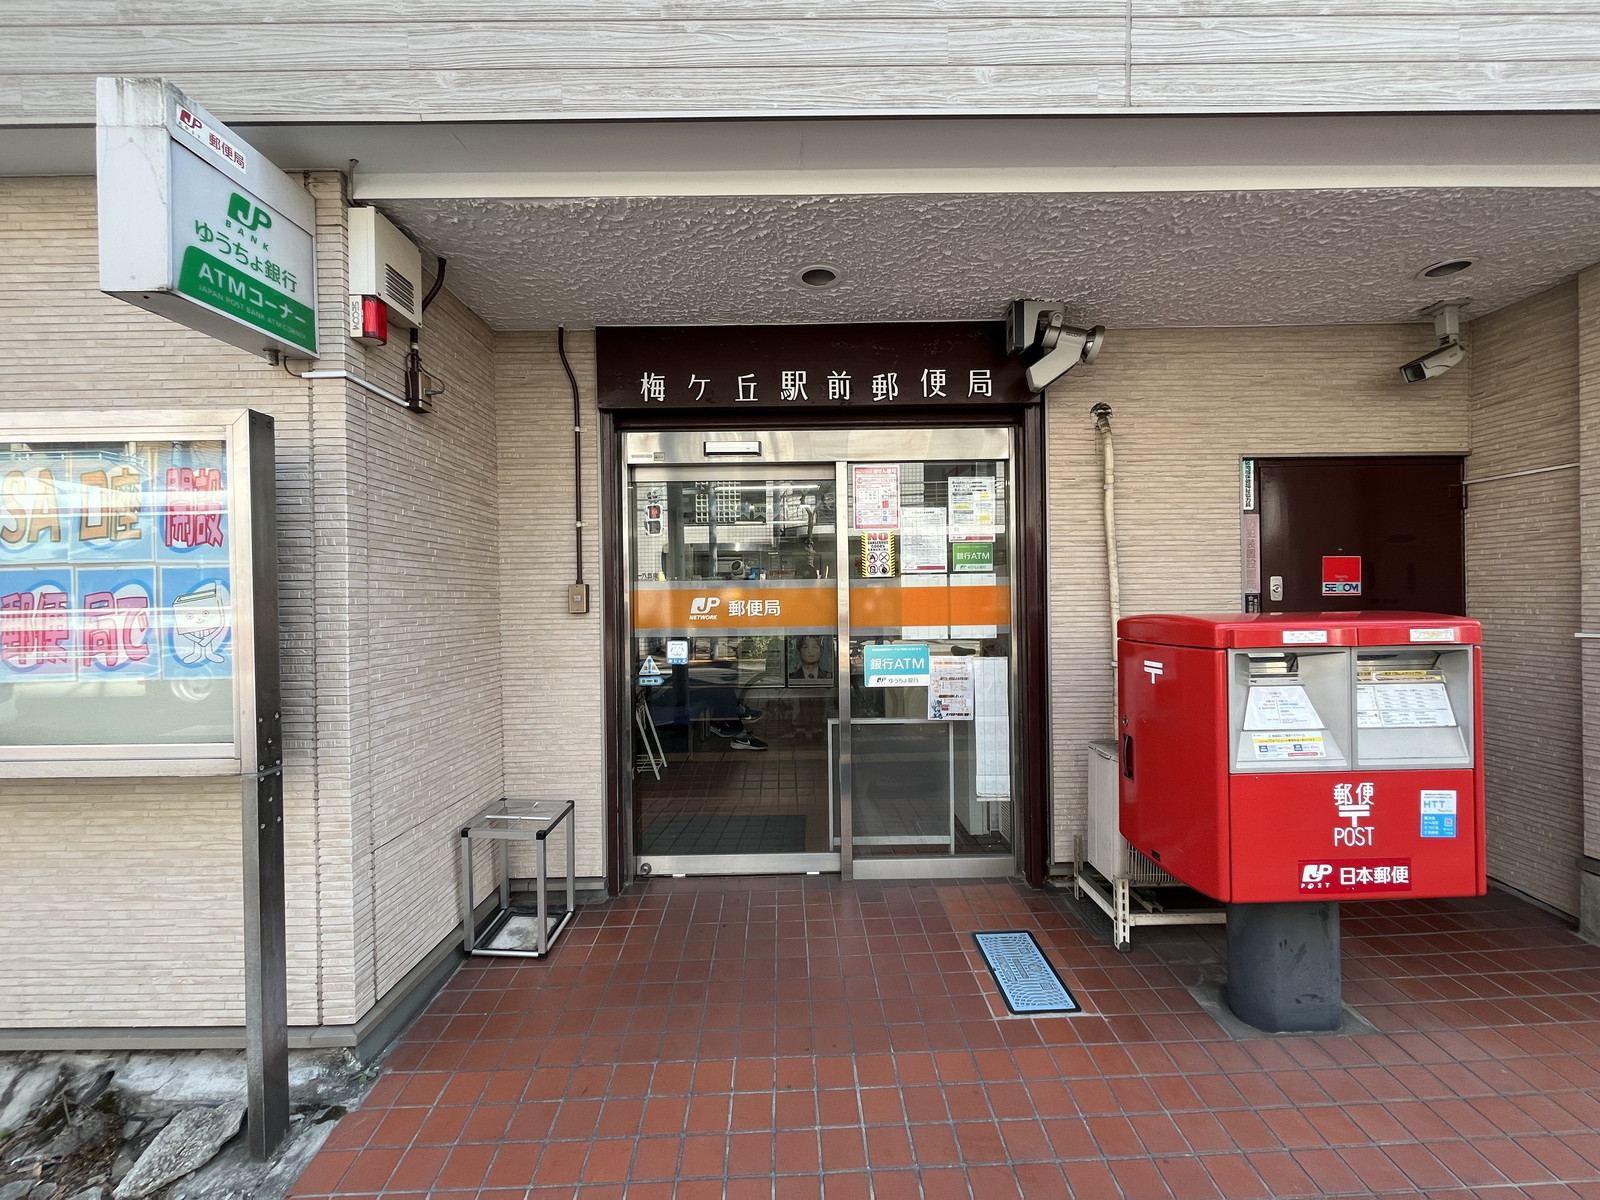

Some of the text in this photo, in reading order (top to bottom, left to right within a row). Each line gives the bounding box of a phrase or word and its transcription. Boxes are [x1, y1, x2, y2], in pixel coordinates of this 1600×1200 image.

[208, 132, 245, 169] 郵便局
[228, 192, 272, 231] JP
[225, 219, 269, 251] BANK
[195, 219, 297, 293] ゆうちょ銀行
[198, 263, 306, 324] ATMコーナー
[199, 285, 224, 301] JAPAN
[225, 296, 244, 311] POST
[246, 307, 265, 321] BANK
[352, 301, 360, 330] SECOM
[867, 532, 888, 540] NO
[956, 552, 990, 560] 銀行ATM
[1324, 583, 1359, 592] SECOM
[690, 597, 720, 614] JP
[728, 600, 781, 617] 郵便局
[870, 658, 925, 670] 銀行ATM
[1333, 782, 1375, 806] 郵便
[1423, 800, 1446, 808] HTT
[1333, 827, 1375, 847] POST
[1340, 866, 1409, 885] 日本郵便
